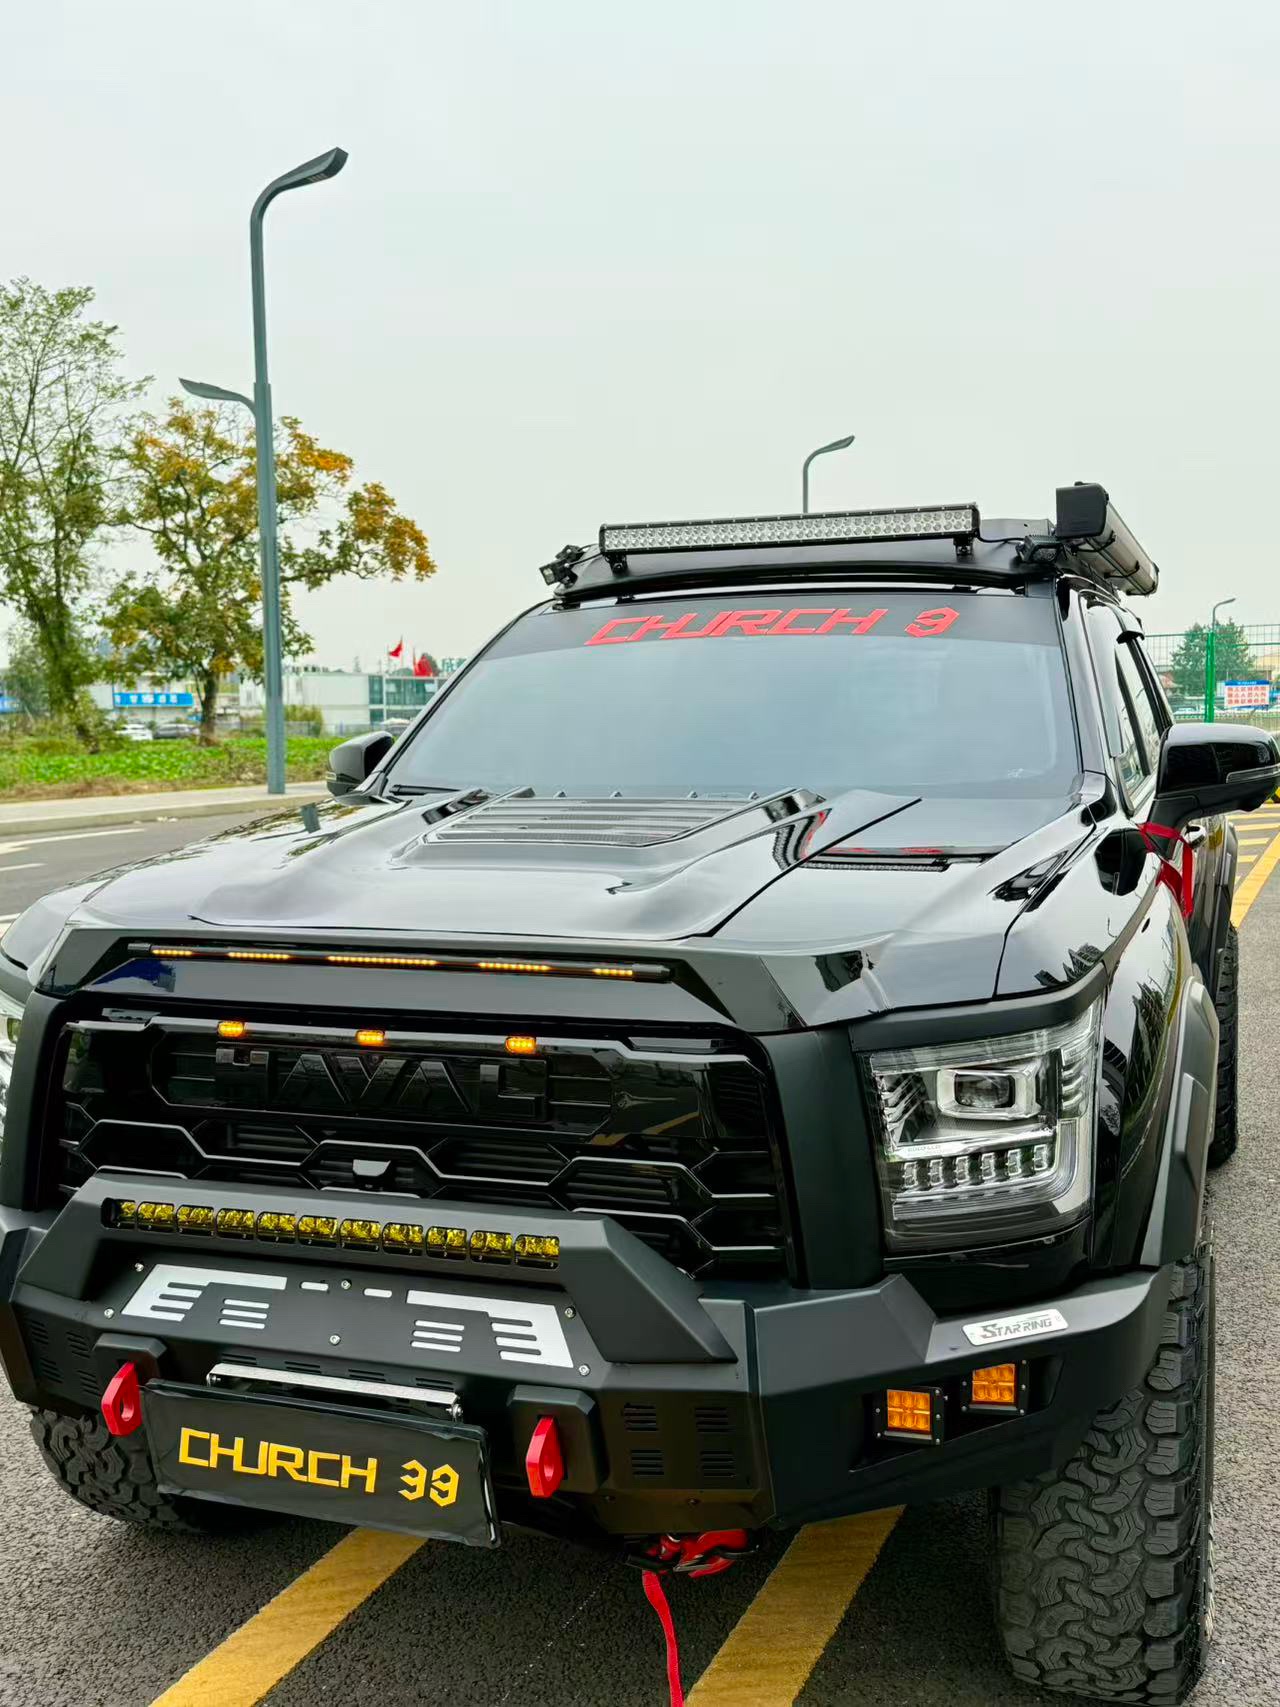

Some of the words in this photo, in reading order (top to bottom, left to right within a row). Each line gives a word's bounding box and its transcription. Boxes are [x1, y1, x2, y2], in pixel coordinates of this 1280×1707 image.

[584, 608, 889, 645] CHURCH
[905, 607, 960, 638] 9
[179, 1427, 378, 1493] CHURCH
